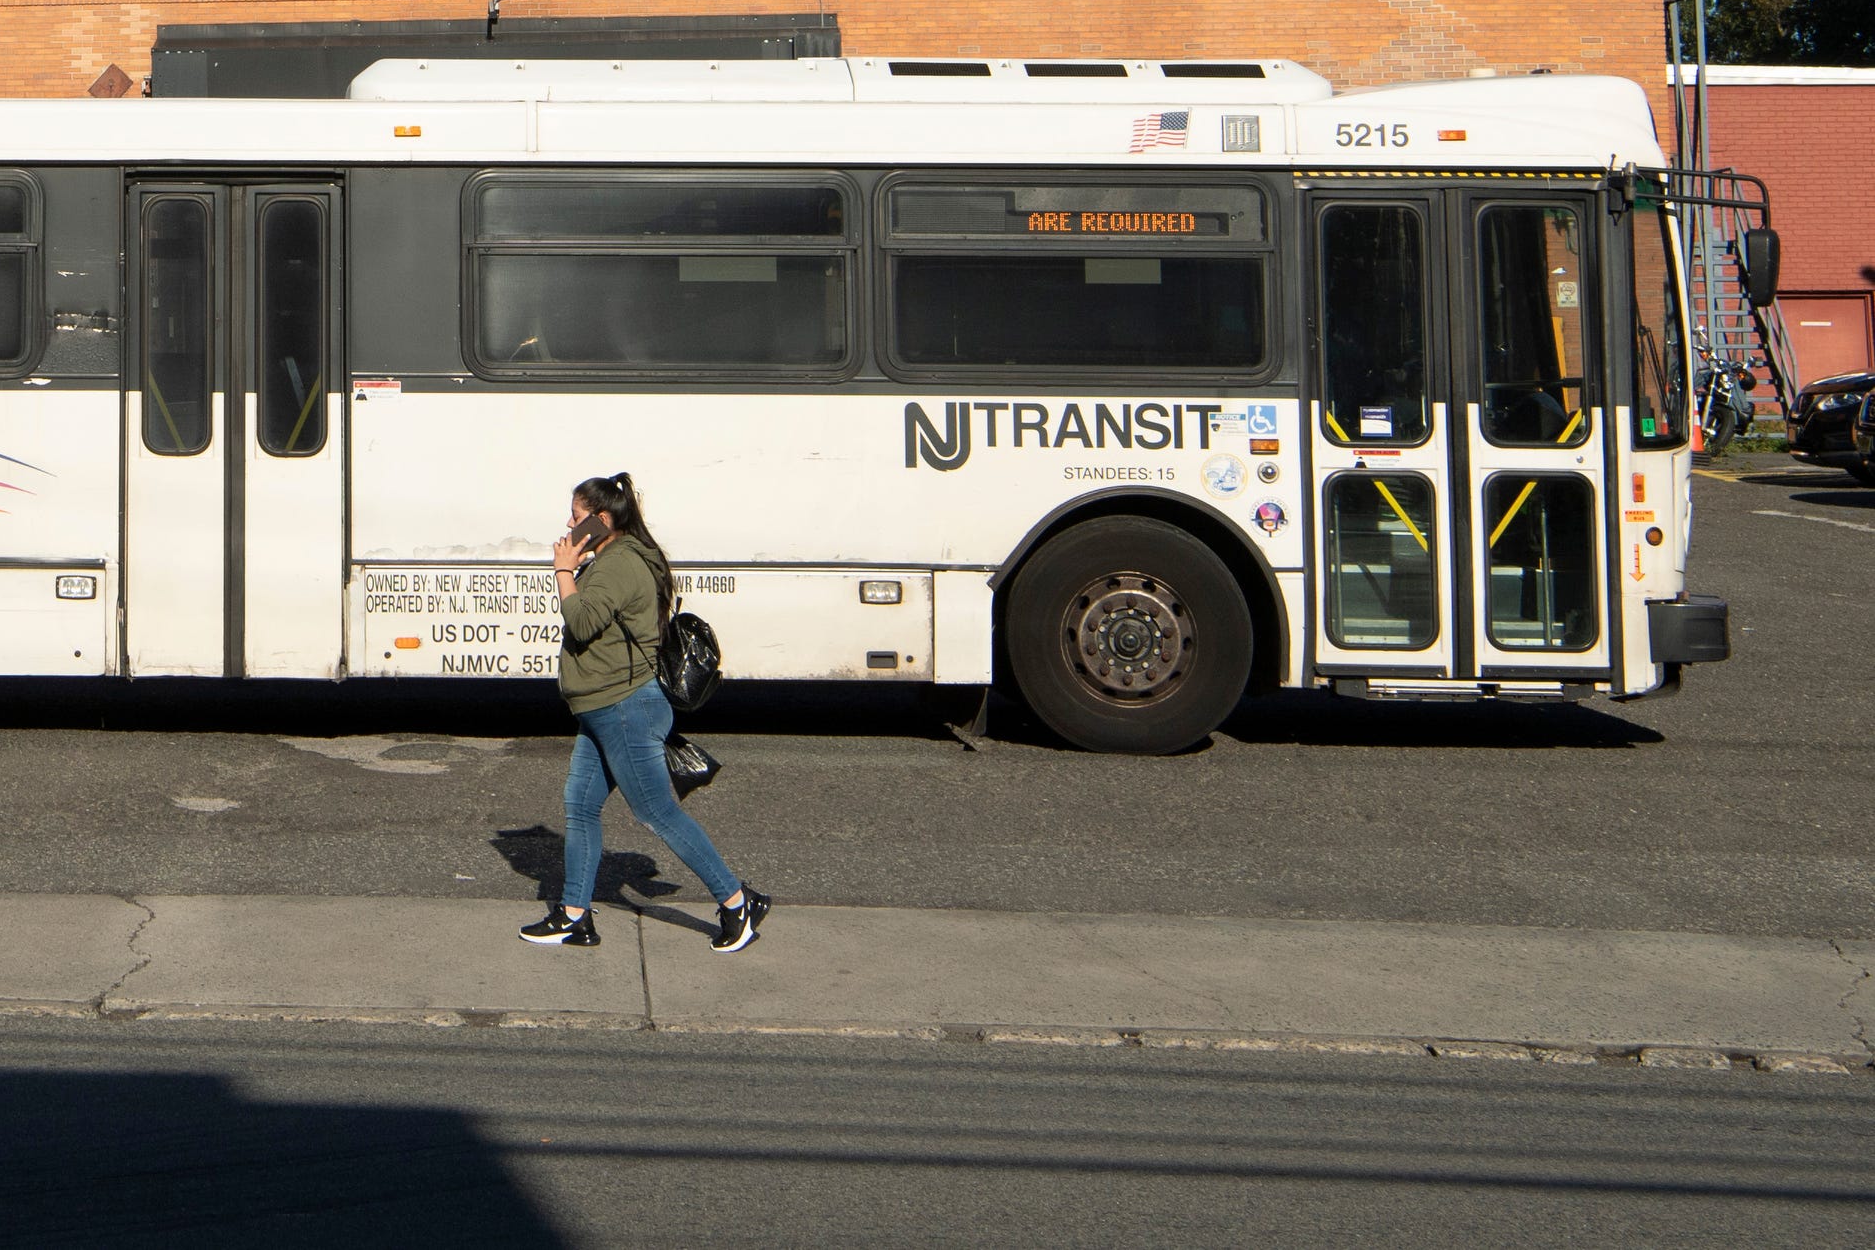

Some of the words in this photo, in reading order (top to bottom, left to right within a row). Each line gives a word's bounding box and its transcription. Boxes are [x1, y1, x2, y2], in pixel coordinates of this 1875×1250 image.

[1336, 123, 1409, 147] 5215
[1028, 212, 1072, 231] ARE
[1081, 212, 1196, 232] REQUIRED
[973, 403, 1222, 450] TRANSIT
[1064, 467, 1152, 480] STANDEES:
[1157, 467, 1175, 480] 15
[366, 574, 408, 593] OWNED
[413, 574, 431, 593] BY:
[435, 575, 461, 592] NEW
[466, 575, 509, 593] JERSEY
[514, 575, 556, 593] TRANSI
[673, 576, 692, 593] WR
[696, 576, 735, 593] 44660
[366, 595, 423, 613] OPERATED
[427, 595, 445, 613] BY:
[449, 596, 469, 613] N.J.
[473, 596, 519, 614] TRANSIT
[524, 596, 547, 614] BUS
[432, 624, 457, 643] US
[463, 625, 500, 643] DOT
[442, 654, 510, 673] NJMVC
[522, 655, 559, 673] 551
